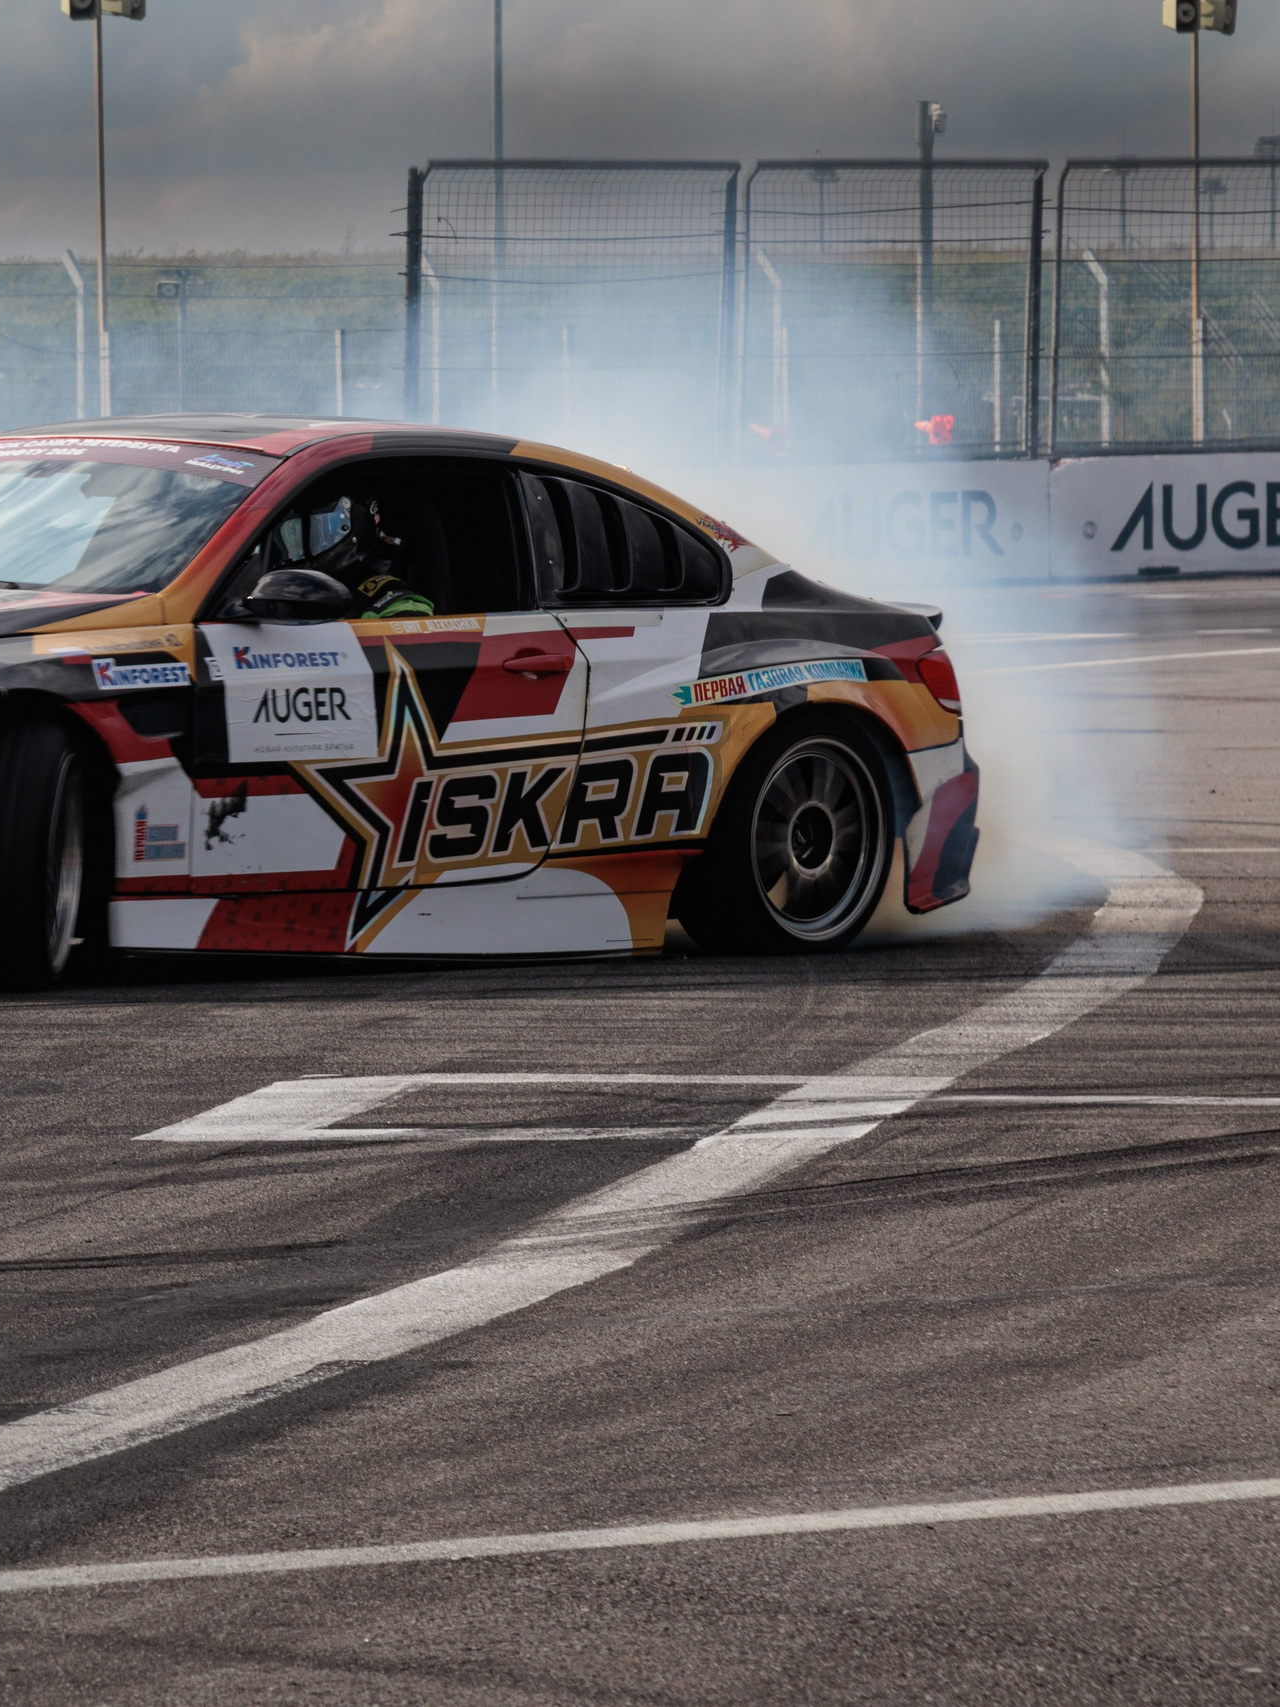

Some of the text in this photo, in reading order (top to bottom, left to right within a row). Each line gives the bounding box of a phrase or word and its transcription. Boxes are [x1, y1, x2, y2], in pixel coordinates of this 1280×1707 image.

[23, 439, 181, 453] САНКТ-ПЕТЕРБУРГА
[807, 488, 1006, 562] AUGER
[96, 661, 188, 686] KINFOREST
[232, 646, 340, 670] KINFOREST
[693, 660, 865, 703] ПЕРВАЯ ГАЗОВАЯ КОМПАНИЯ
[252, 686, 352, 723] AUGER
[395, 748, 712, 866] ISKRA
